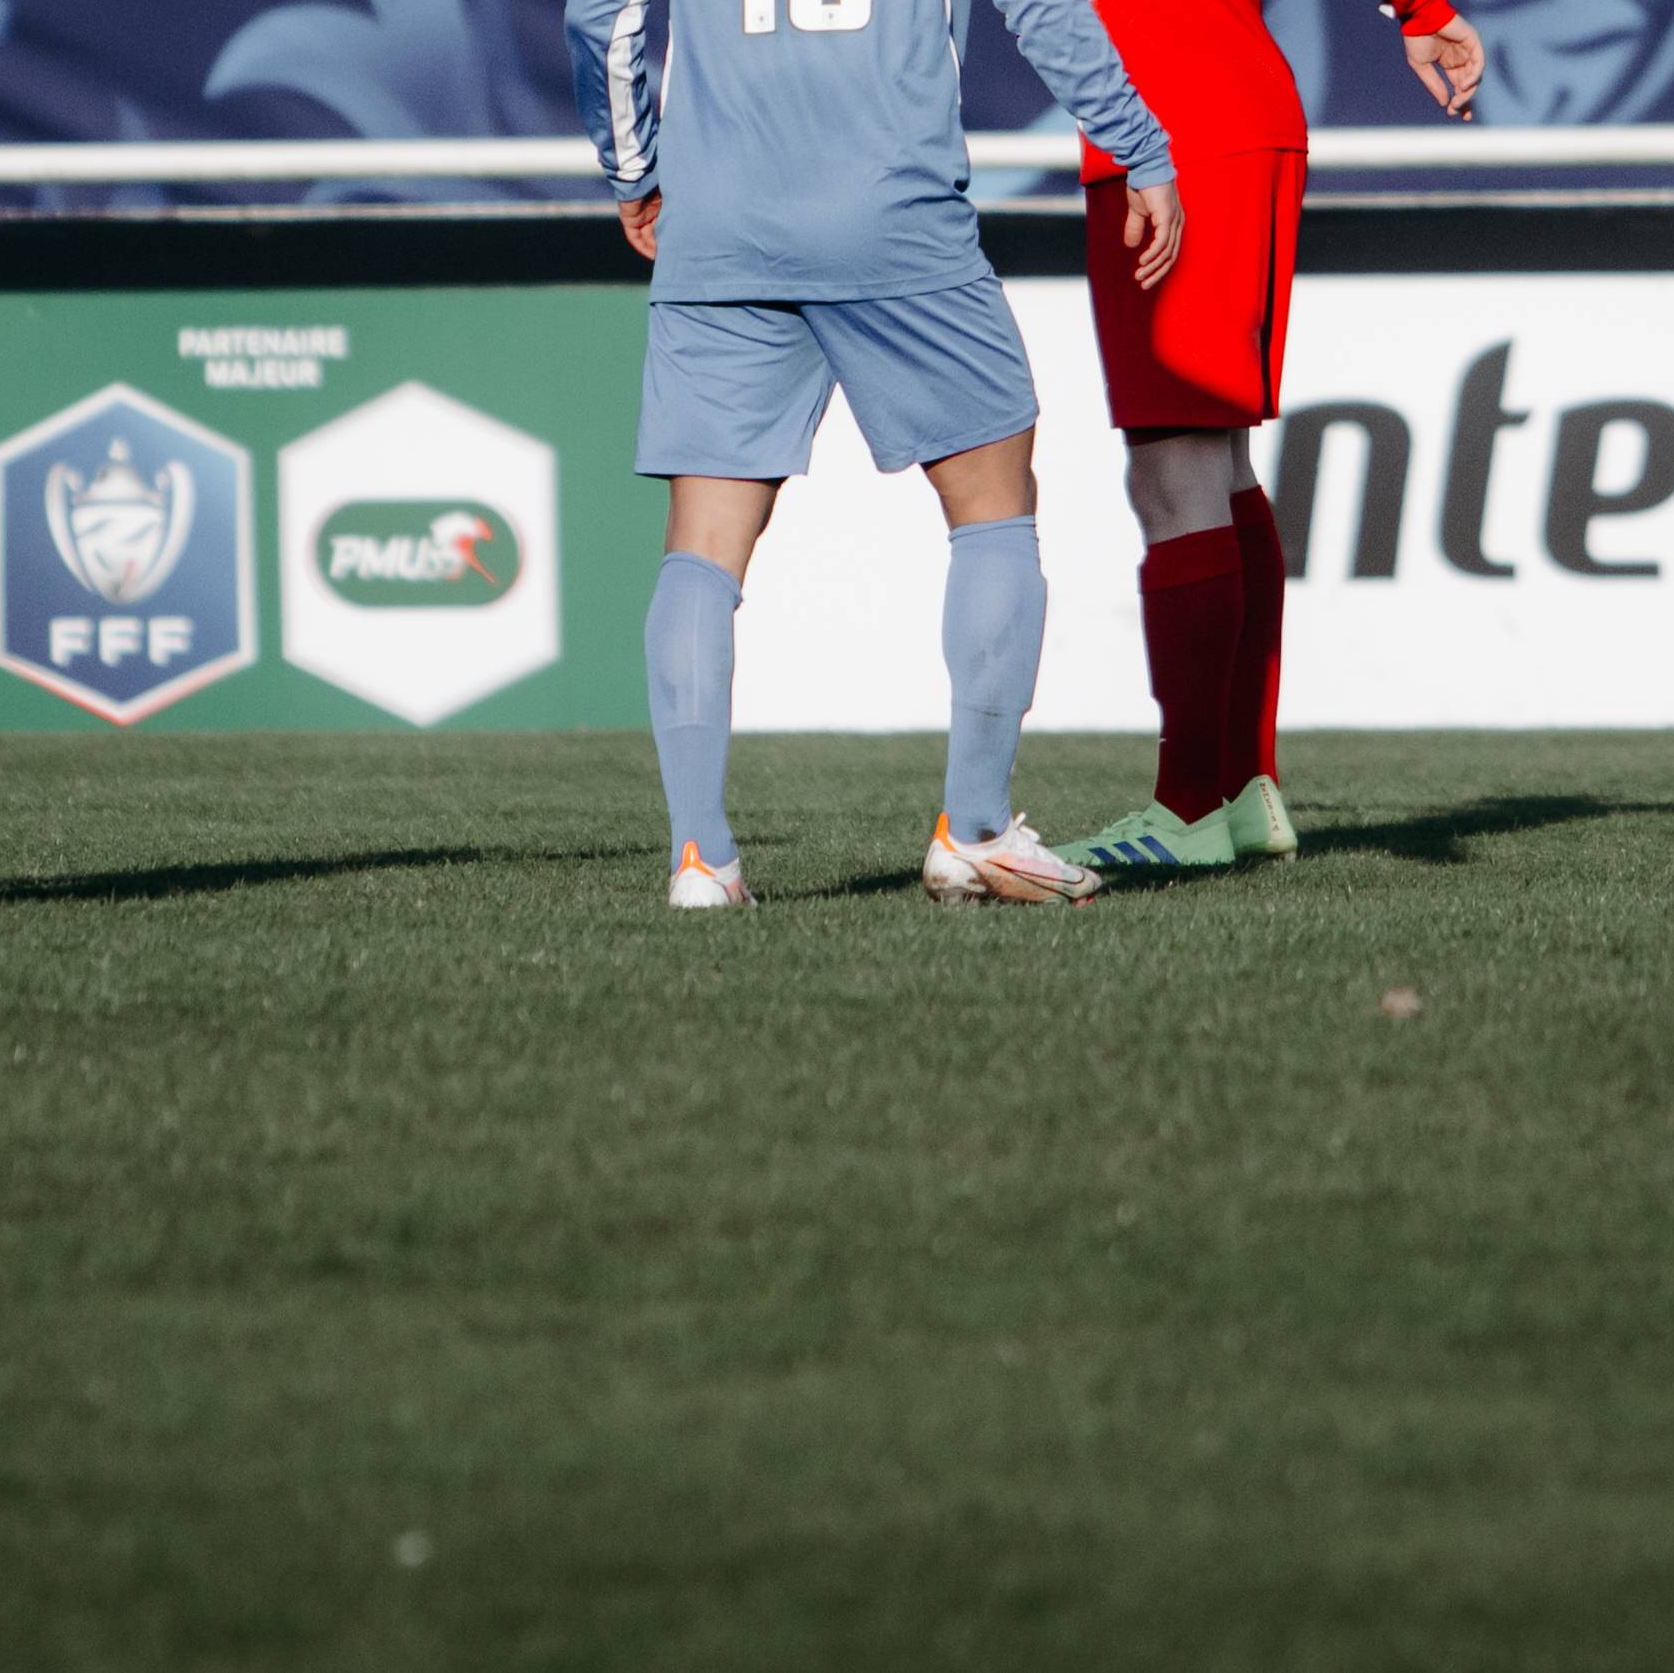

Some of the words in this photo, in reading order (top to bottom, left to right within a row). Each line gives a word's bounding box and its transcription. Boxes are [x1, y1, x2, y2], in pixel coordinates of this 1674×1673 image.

[178, 326, 349, 359] PARTENAIRE
[204, 358, 323, 389] MAJEUR
[329, 534, 433, 581] PMU
[48, 616, 195, 667] FFF
